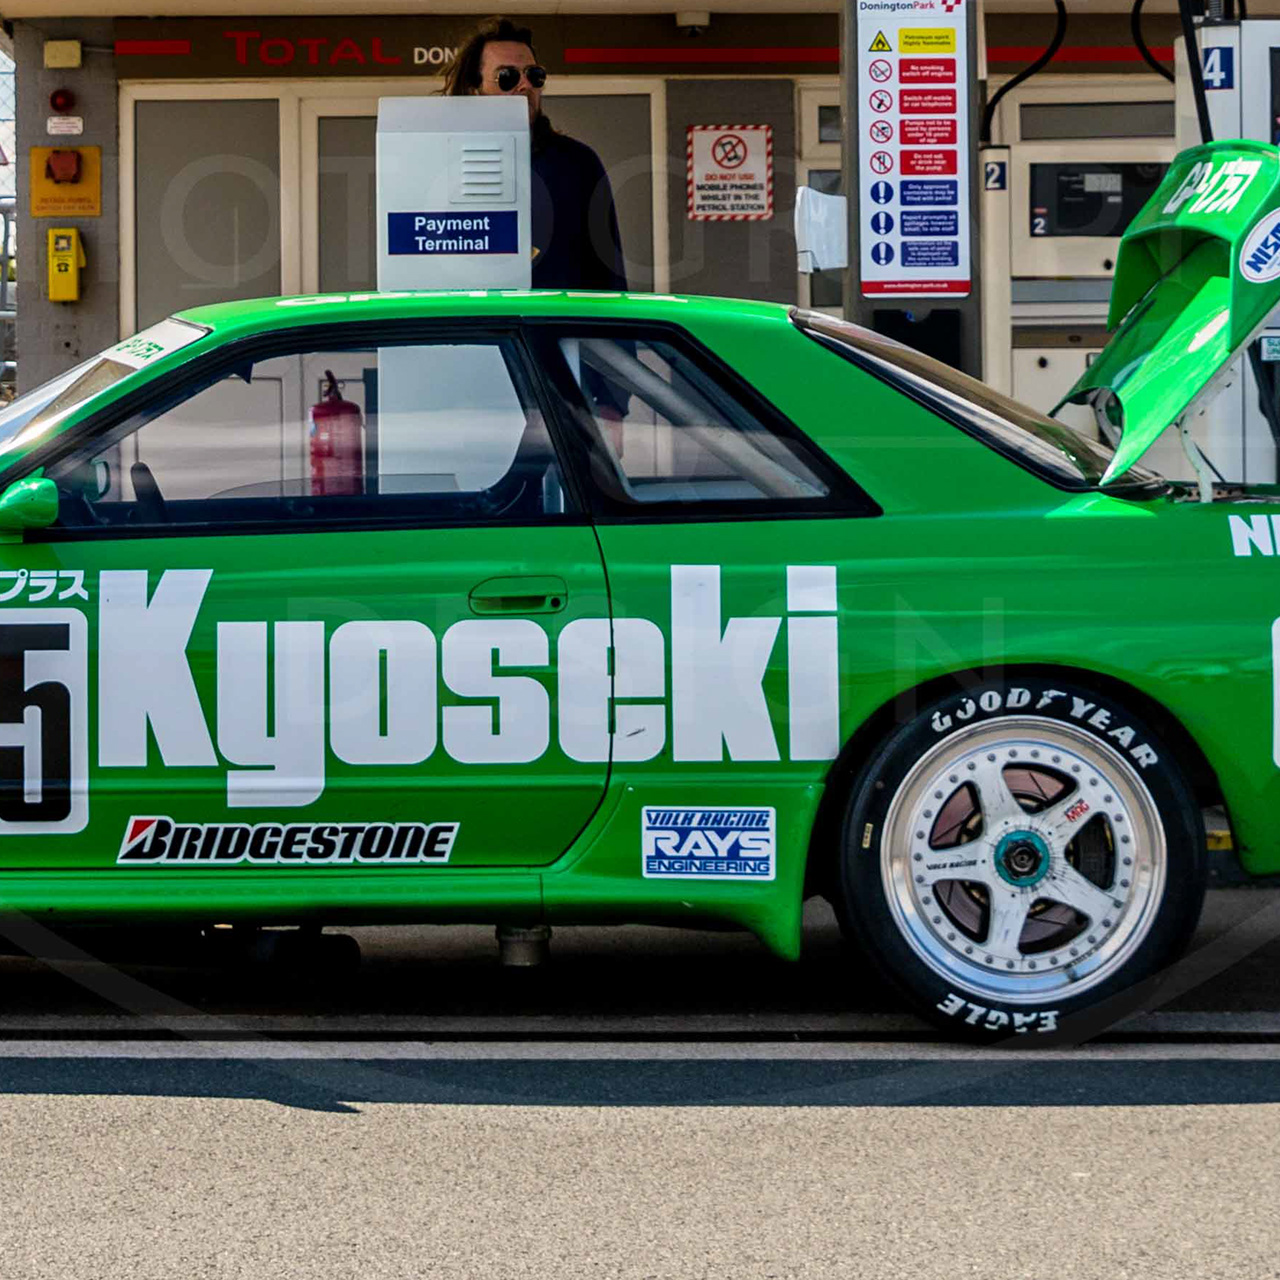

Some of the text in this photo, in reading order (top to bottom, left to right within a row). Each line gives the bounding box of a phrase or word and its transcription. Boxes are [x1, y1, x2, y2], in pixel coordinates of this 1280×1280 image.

[222, 30, 402, 66] TOTAL
[1203, 47, 1226, 87] 4
[985, 163, 1001, 189] 2
[696, 183, 765, 191] MOBILE PHONES
[700, 193, 731, 201] WHILST
[696, 203, 765, 211] PETROL STATION
[414, 216, 490, 235] Payment
[1033, 217, 1046, 234] 2
[415, 236, 490, 251] Terminal
[97, 565, 839, 809] Kyoseki
[646, 812, 770, 826] VOLK RACING
[120, 817, 457, 863] BRIDGESTONE
[643, 829, 771, 858] RAYS
[646, 859, 770, 872] ENGINEERING
[936, 992, 1060, 1033] EAGLE
